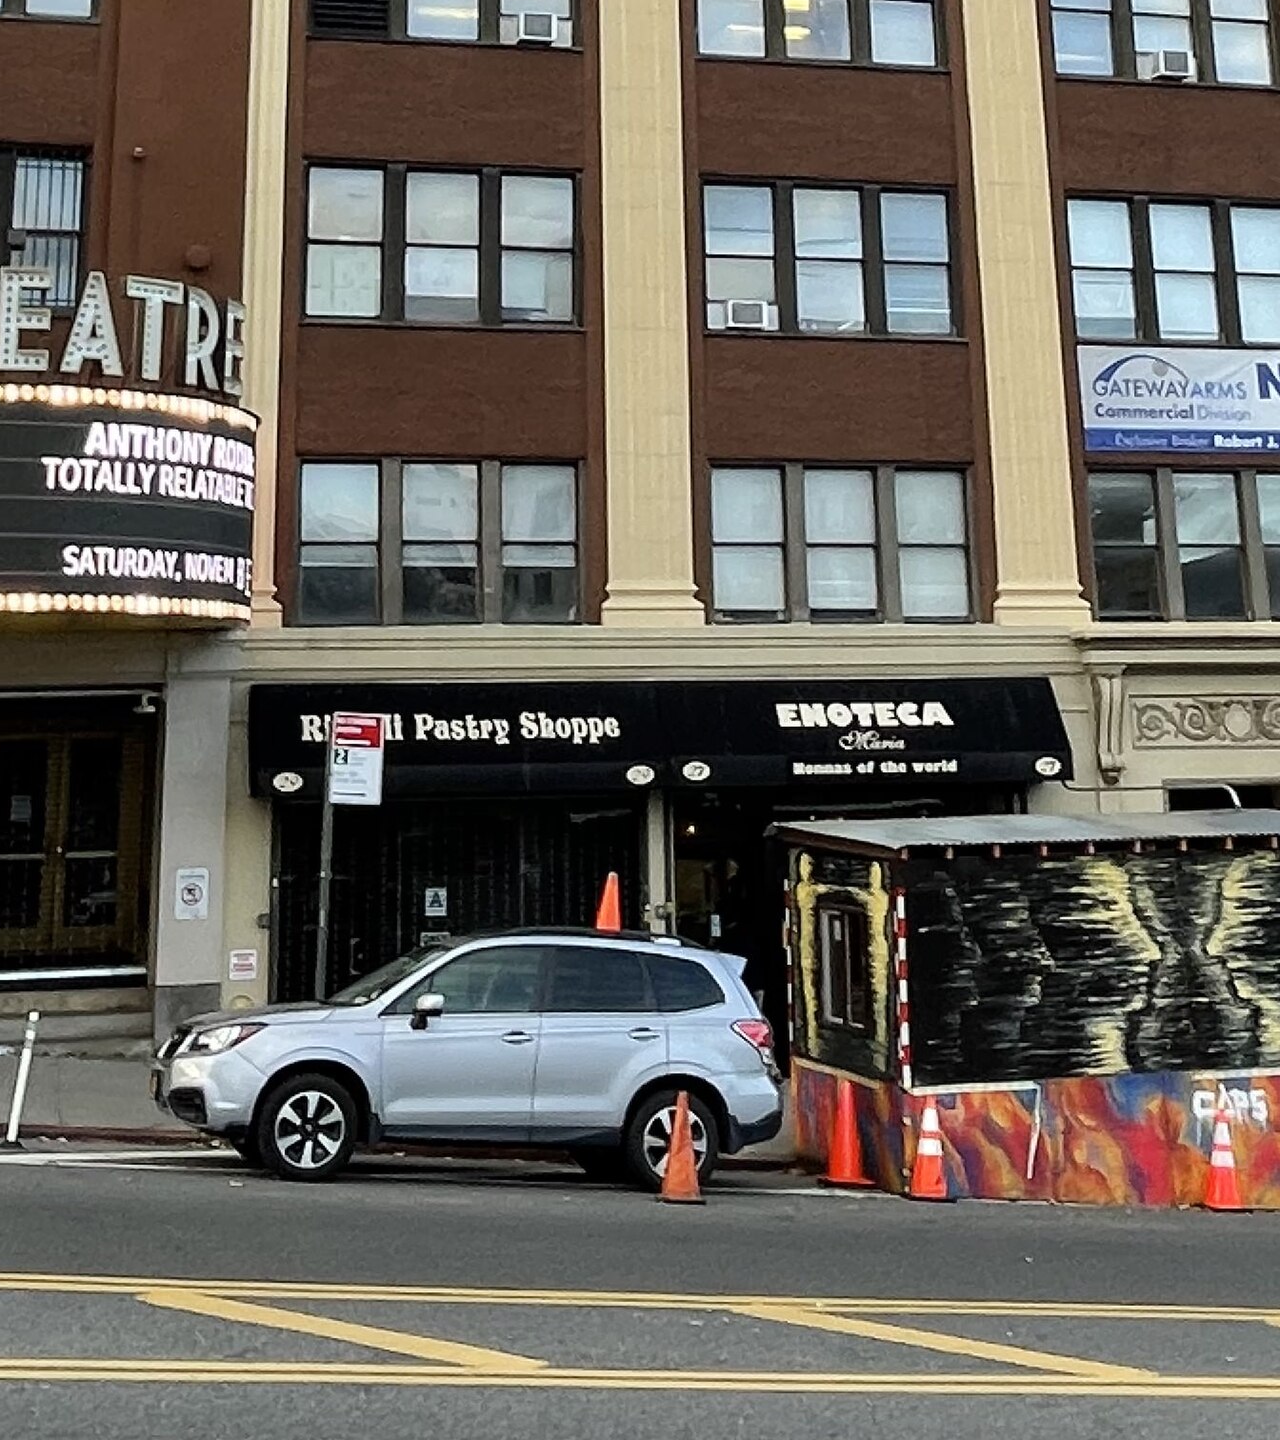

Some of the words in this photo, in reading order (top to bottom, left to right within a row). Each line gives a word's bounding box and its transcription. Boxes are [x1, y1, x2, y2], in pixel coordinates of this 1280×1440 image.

[1094, 402, 1194, 419] Commercial
[84, 421, 213, 466] ANTHONY
[40, 456, 156, 495] TOTALLY
[158, 464, 245, 506] RELATABLE
[62, 544, 182, 582] SATURDAY,
[414, 713, 510, 745] Pastry
[519, 711, 621, 745] Shoppe
[775, 702, 955, 728] ENOTECA
[856, 760, 874, 773] of
[880, 760, 908, 773] the
[911, 759, 959, 773] world
